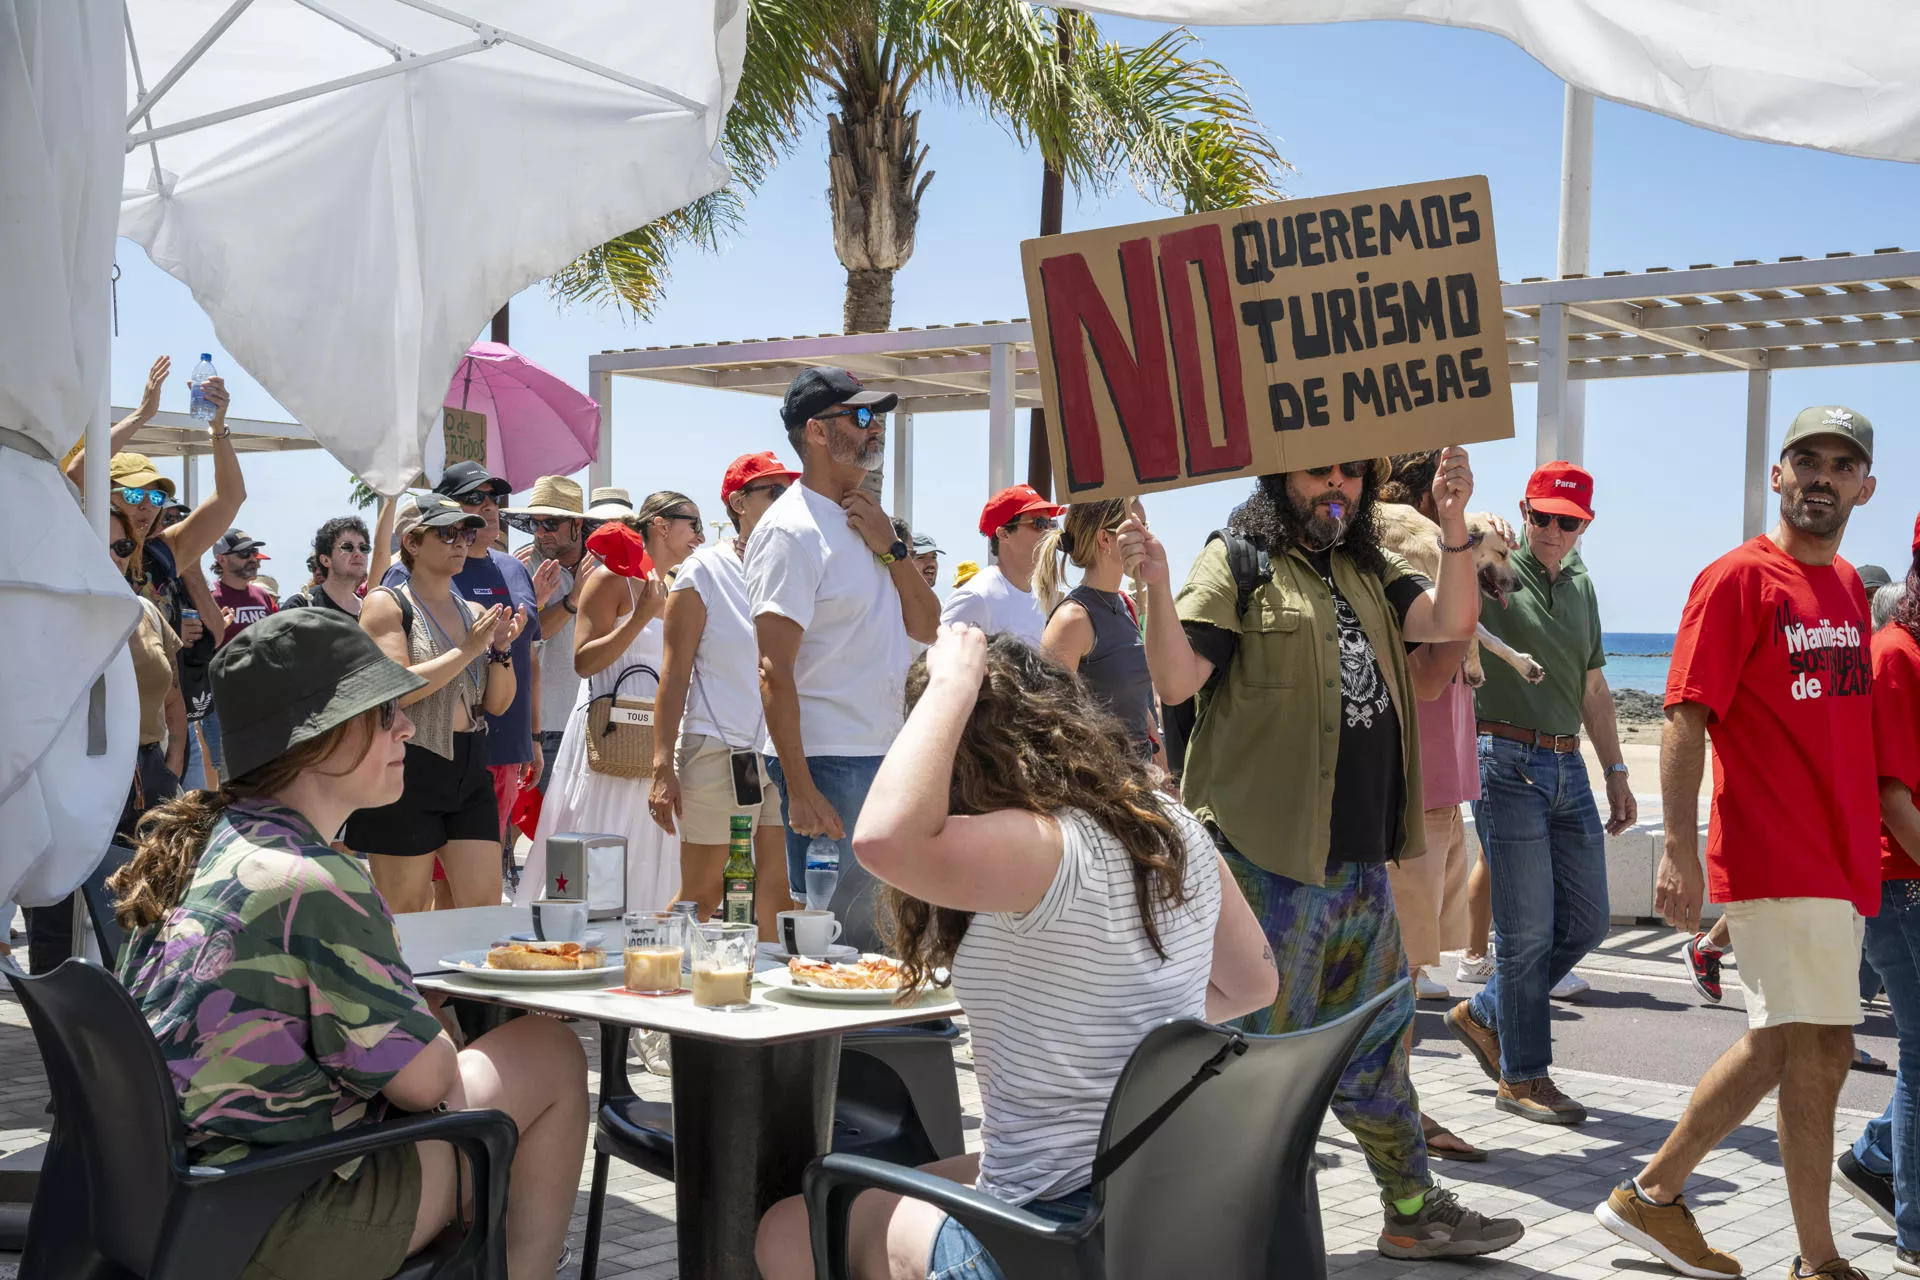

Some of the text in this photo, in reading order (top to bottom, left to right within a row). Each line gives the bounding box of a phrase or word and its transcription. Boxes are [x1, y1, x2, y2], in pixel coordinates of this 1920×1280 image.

[1233, 191, 1481, 285] QUEREMOS
[1040, 224, 1252, 492] NO
[1269, 348, 1491, 432] DE MASAS
[1555, 479, 1577, 489] Parar
[233, 605, 268, 624] VANS
[1791, 672, 1822, 700] de
[627, 712, 649, 722] TOUS
